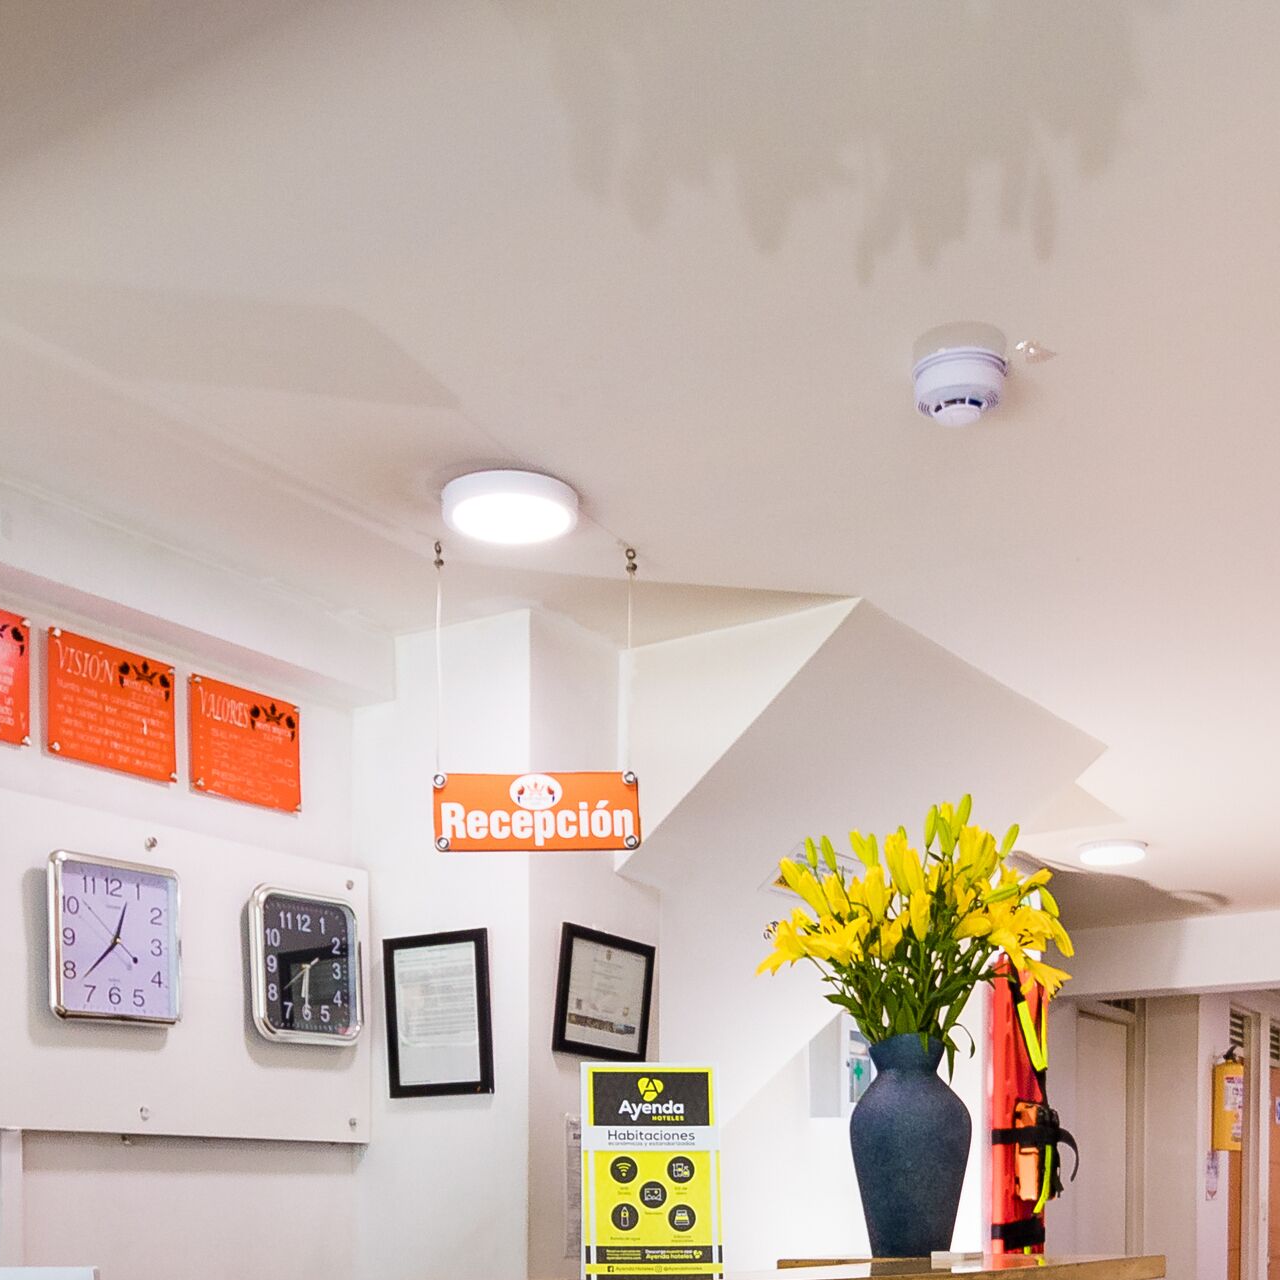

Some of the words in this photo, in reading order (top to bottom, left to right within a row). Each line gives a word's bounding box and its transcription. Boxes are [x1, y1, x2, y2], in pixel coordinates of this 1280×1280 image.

[440, 800, 634, 846] Recepción
[83, 875, 96, 894] 11
[104, 877, 123, 897] 12
[135, 882, 140, 900] 1
[62, 895, 79, 915] 10
[150, 907, 162, 926] 2
[279, 911, 292, 930] 11
[296, 913, 311, 932] 12
[319, 917, 325, 935] 1
[62, 927, 75, 946] 9
[265, 927, 280, 947] 10
[150, 938, 162, 956] 3
[331, 937, 341, 955] 2
[63, 960, 76, 979] 8
[266, 955, 278, 973] 9
[332, 963, 341, 980] 3
[150, 971, 162, 988] 4
[84, 984, 96, 1003] 7
[108, 986, 121, 1004] 6
[132, 989, 145, 1007] 5
[267, 984, 278, 1001] 8
[333, 990, 342, 1007] 4
[283, 1002, 293, 1019] 7
[320, 1005, 330, 1022] 5
[618, 1099, 685, 1121] Ayenda
[607, 1129, 696, 1141] Habitaciones
